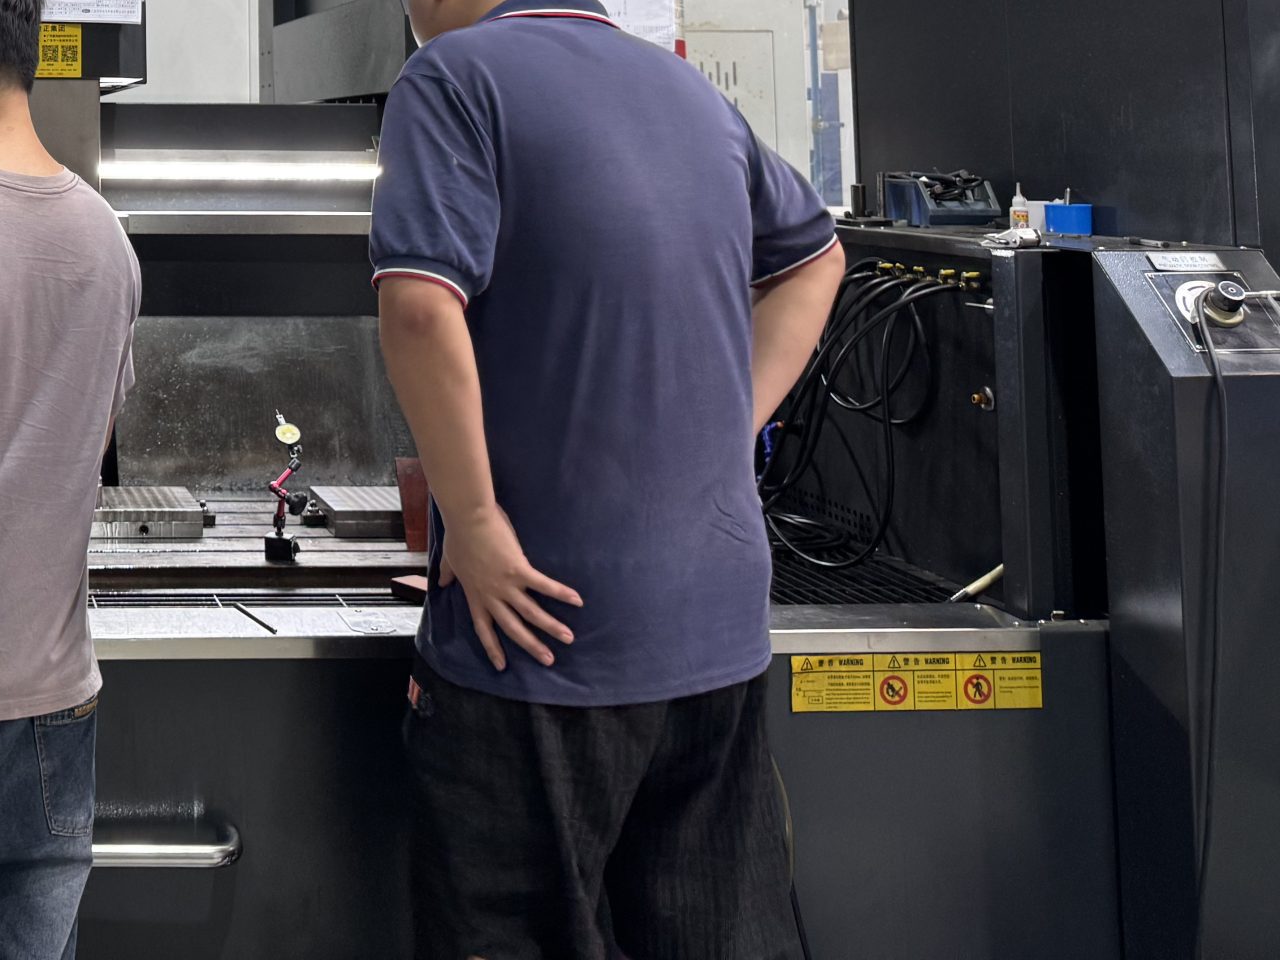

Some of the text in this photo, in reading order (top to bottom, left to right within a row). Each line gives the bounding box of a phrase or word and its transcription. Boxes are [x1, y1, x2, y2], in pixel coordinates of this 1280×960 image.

[838, 658, 864, 666] WARNING
[924, 657, 950, 665] WARNING
[1011, 656, 1037, 664] WARNING
